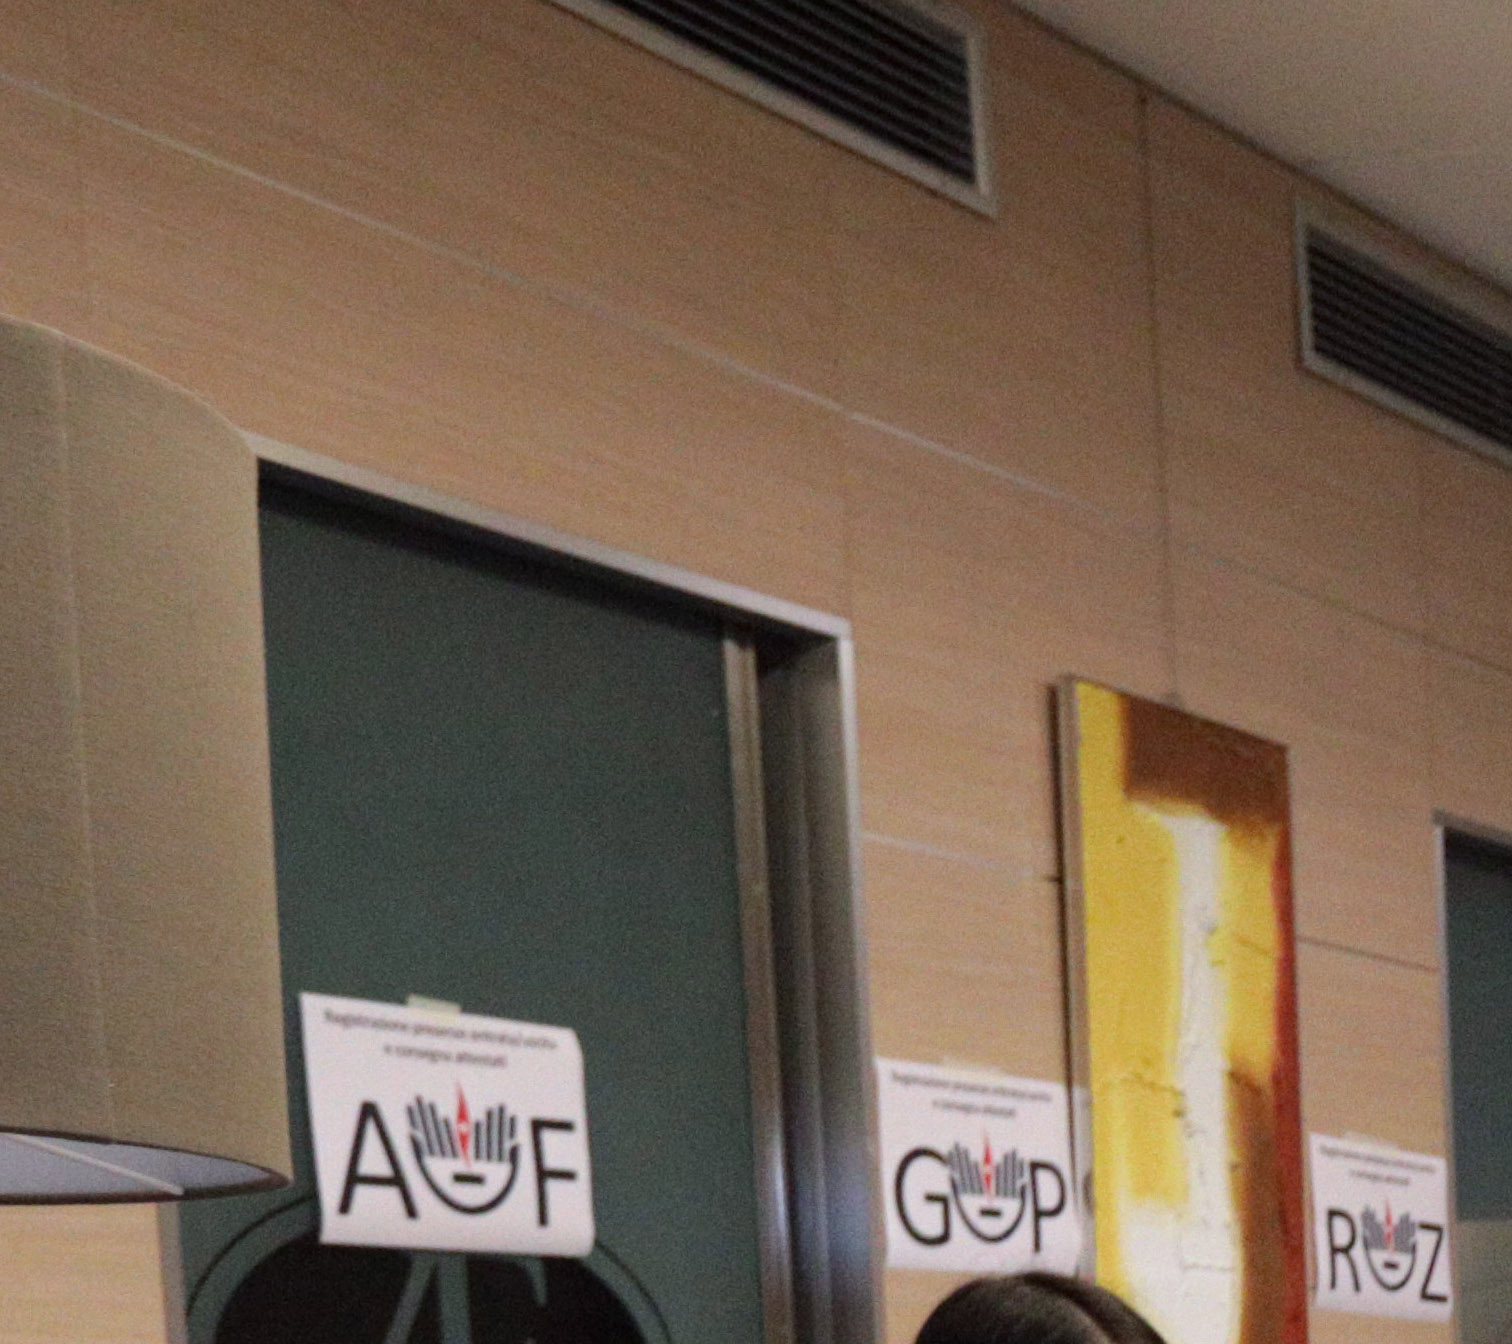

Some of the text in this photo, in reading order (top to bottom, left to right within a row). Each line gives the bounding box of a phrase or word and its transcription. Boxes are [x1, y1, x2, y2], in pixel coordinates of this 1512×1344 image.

[337, 1100, 419, 1220] A
[530, 1117, 578, 1228] F
[894, 1146, 951, 1246] G
[1029, 1160, 1067, 1253] P
[1326, 1208, 1361, 1293] R
[1417, 1222, 1449, 1303] Z
